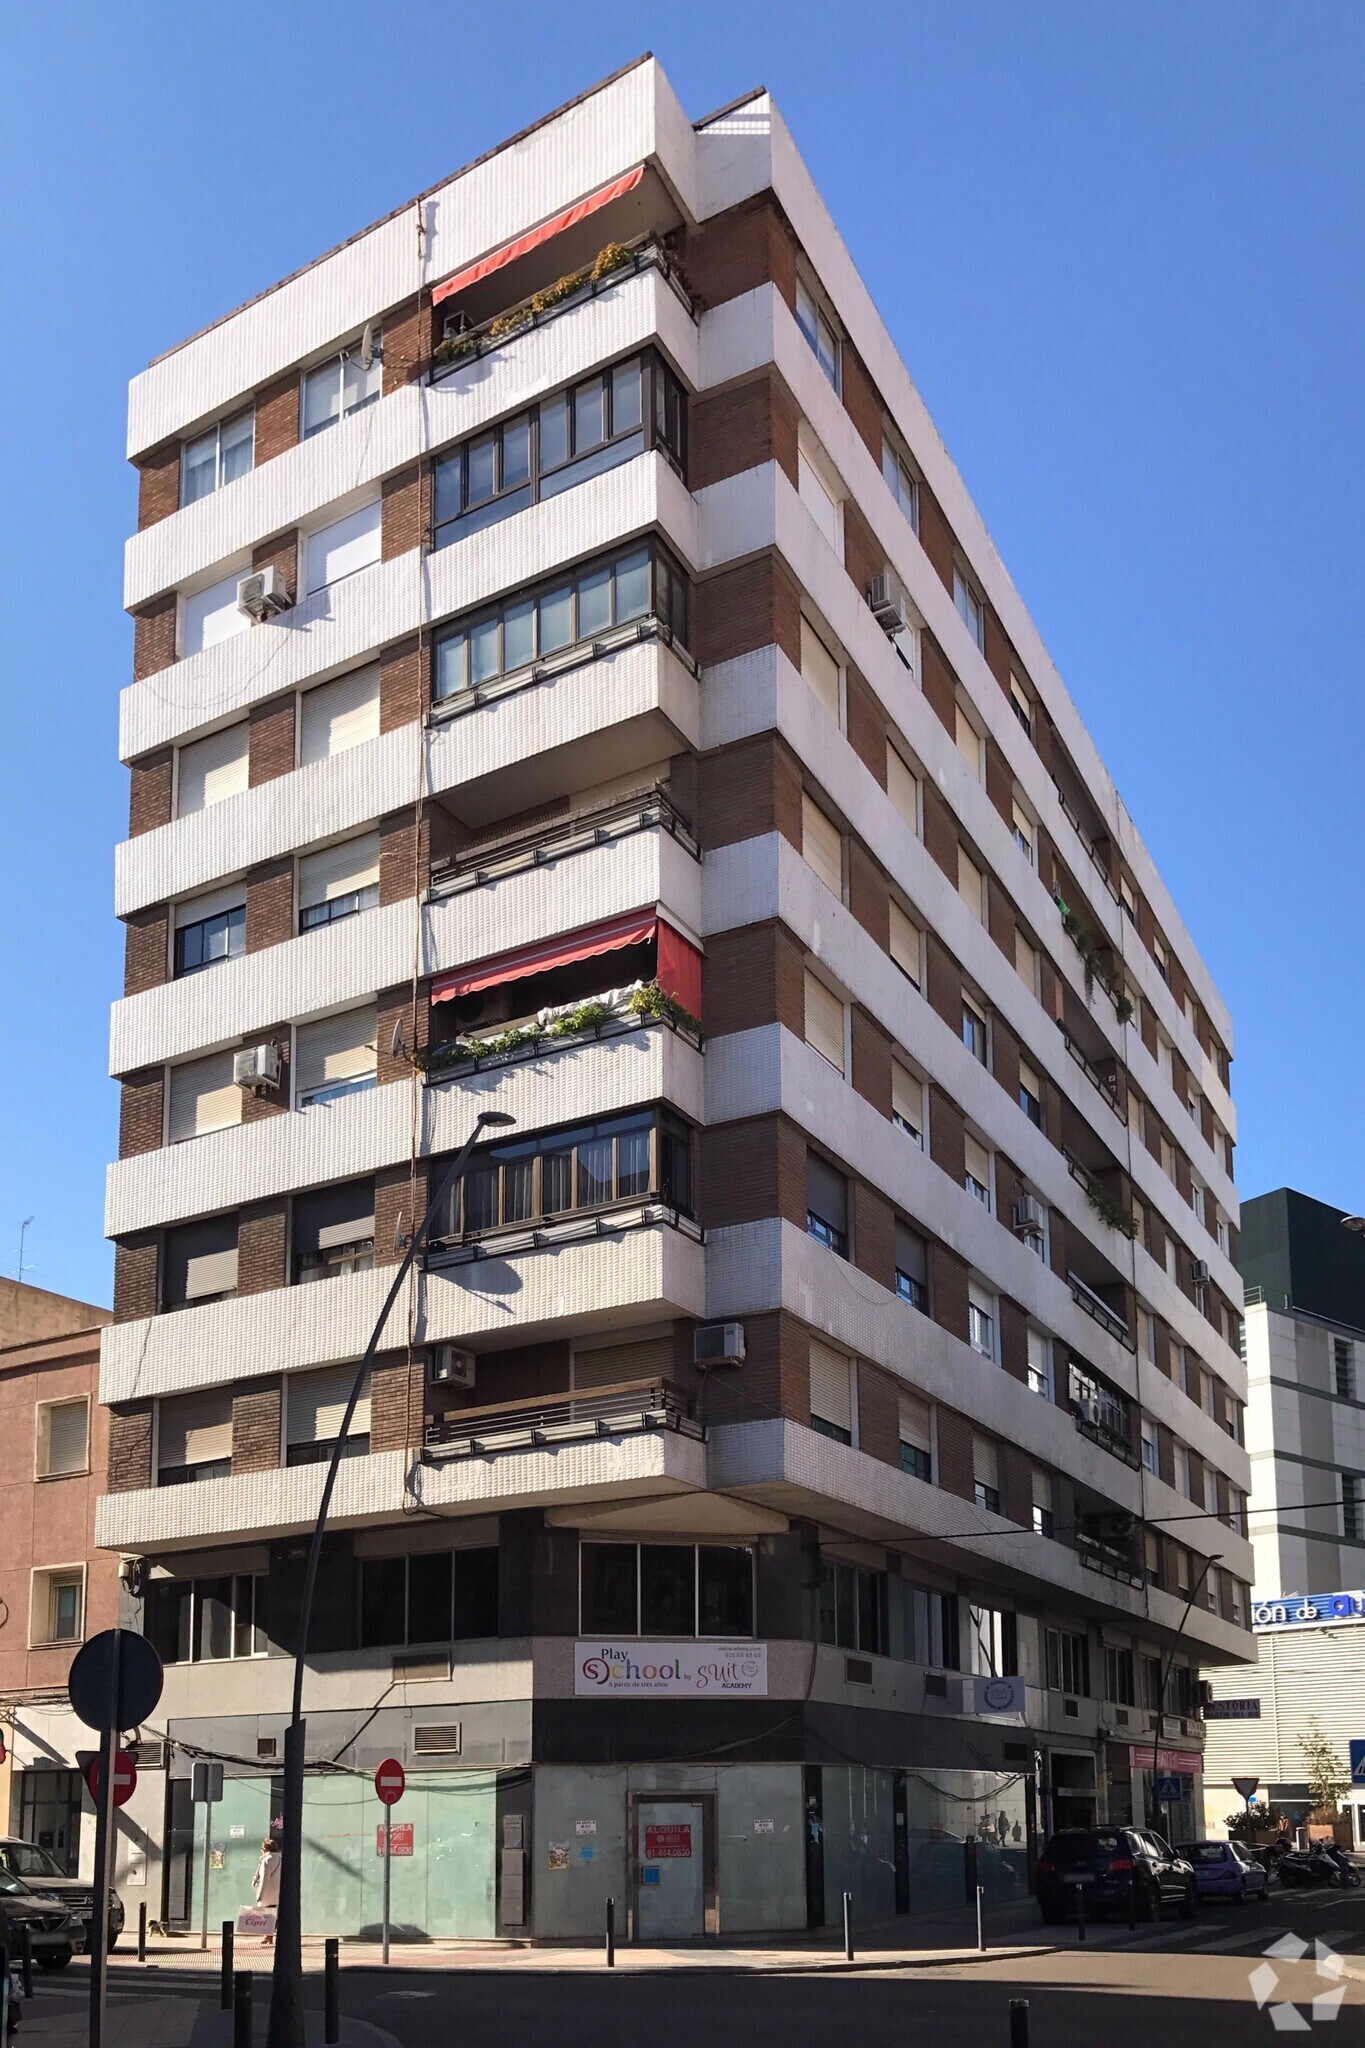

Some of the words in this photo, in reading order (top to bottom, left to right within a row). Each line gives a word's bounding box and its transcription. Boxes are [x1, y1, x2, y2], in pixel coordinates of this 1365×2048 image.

[1296, 1598, 1318, 1619] de
[601, 1648, 628, 1662] Play
[647, 1826, 690, 1834] ALQUILA
